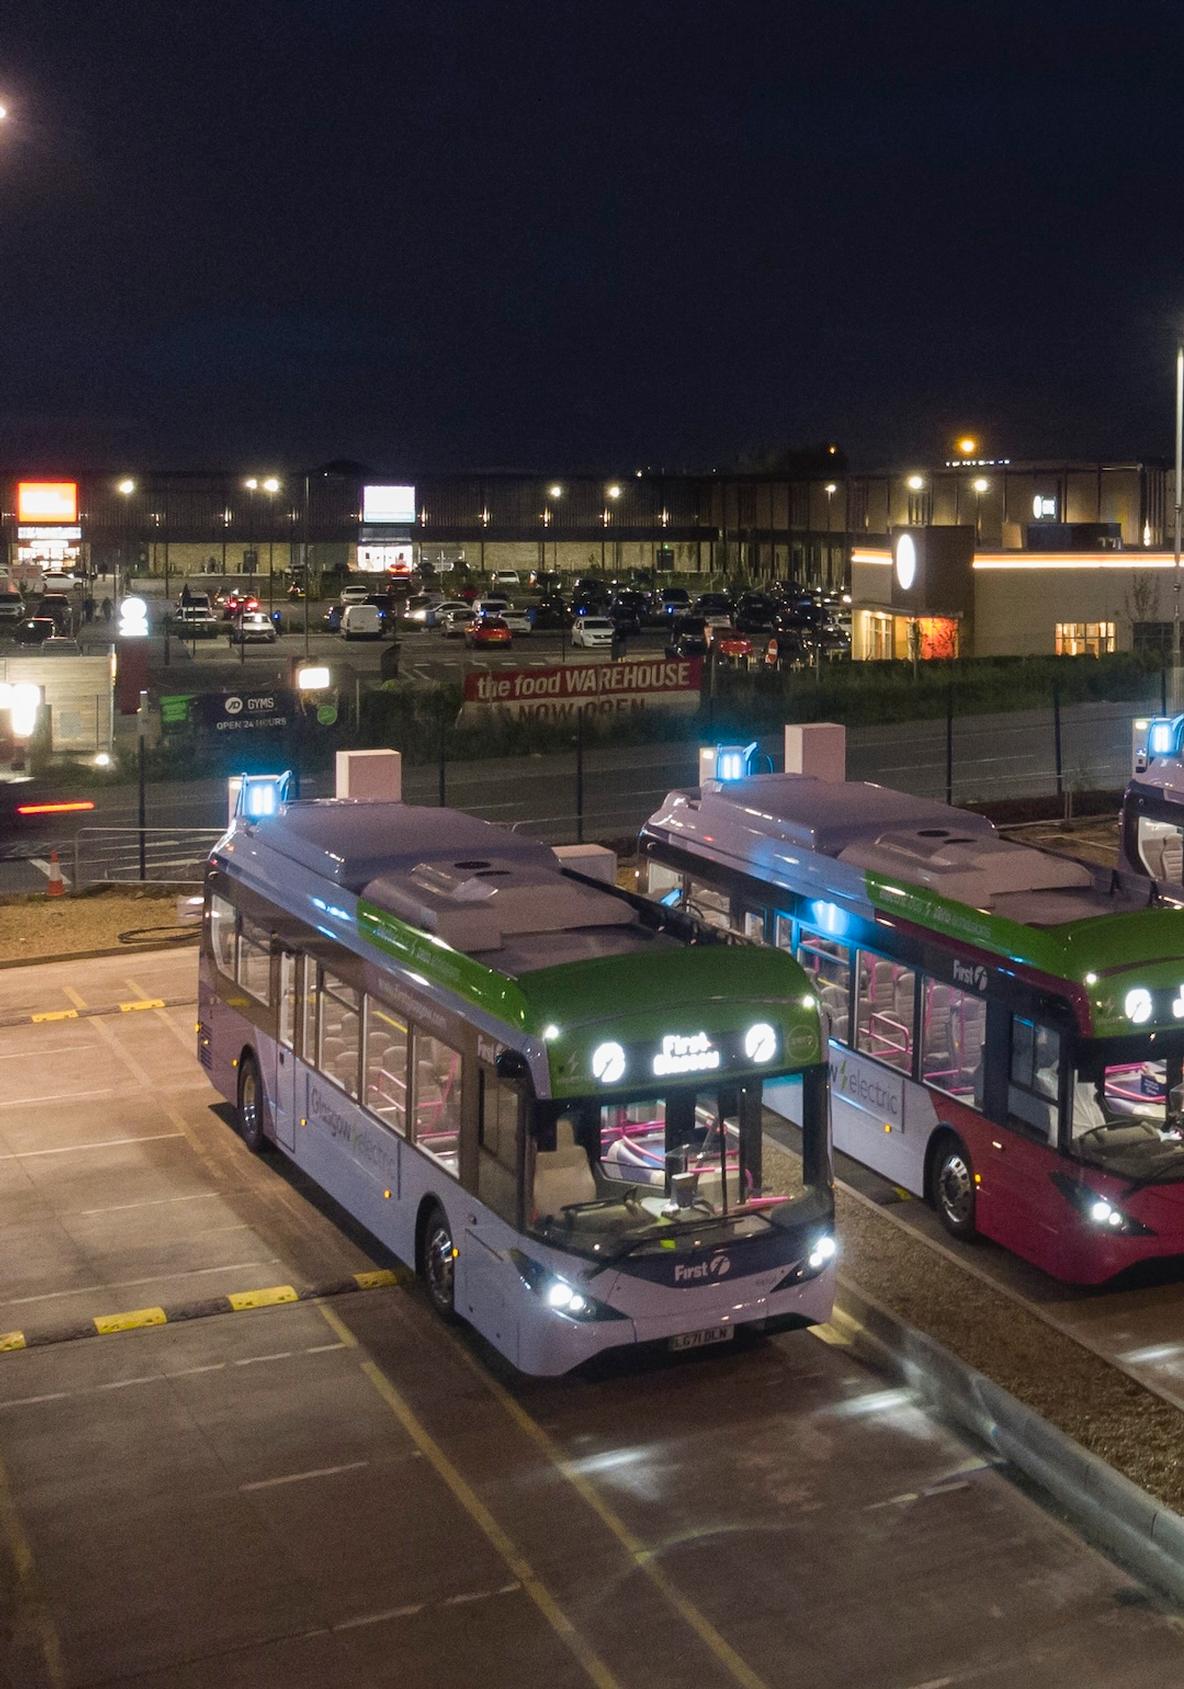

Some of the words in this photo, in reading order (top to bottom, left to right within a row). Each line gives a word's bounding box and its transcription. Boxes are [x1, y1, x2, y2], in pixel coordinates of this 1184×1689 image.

[477, 676, 511, 698] the
[514, 671, 561, 696] food
[565, 662, 690, 693] WAREHOUSE
[247, 697, 274, 710] GYMS
[217, 720, 241, 731] OPEN
[243, 720, 254, 729] 24
[255, 717, 288, 728] HOURS
[953, 959, 973, 985] First
[848, 1068, 898, 1115] electric
[675, 1262, 708, 1281] First
